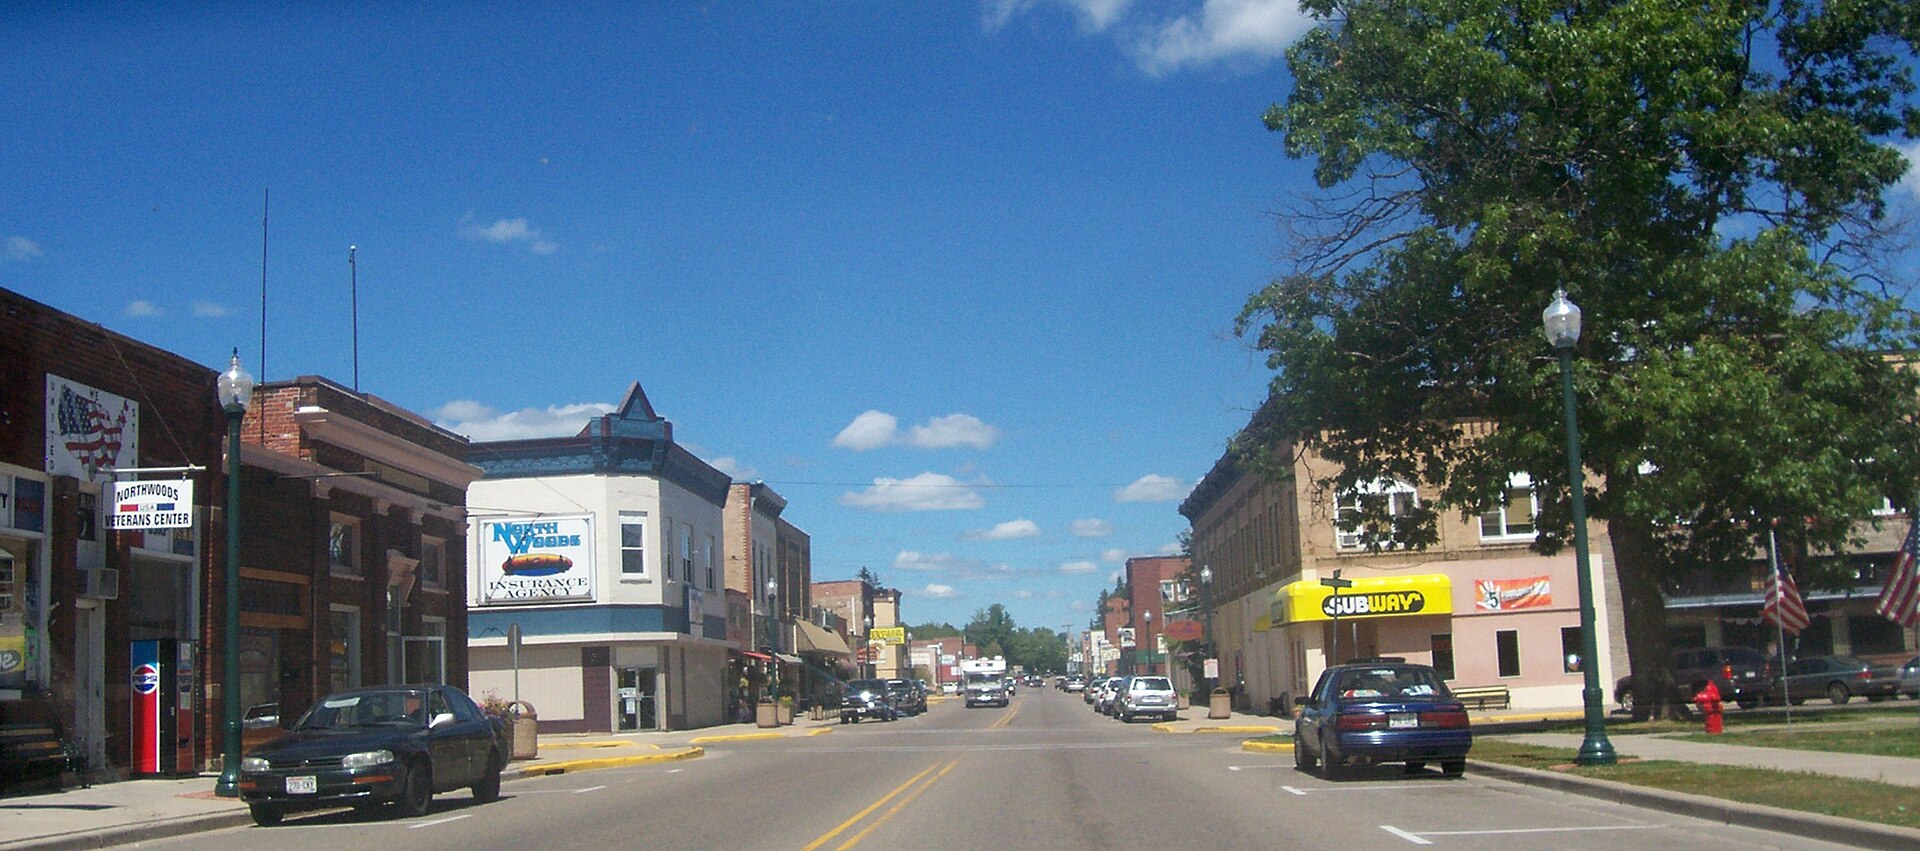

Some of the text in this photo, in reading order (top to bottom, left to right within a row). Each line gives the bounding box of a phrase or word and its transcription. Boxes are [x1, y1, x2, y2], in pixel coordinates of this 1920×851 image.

[116, 483, 179, 503] NORTHWOODS
[105, 513, 189, 527] VETERANS CENTER
[493, 522, 559, 542] NORTH
[510, 535, 581, 553] WOODS
[490, 578, 588, 589] INSURANCE
[504, 587, 571, 598] AGENCY
[1323, 592, 1421, 616] SUBWAY
